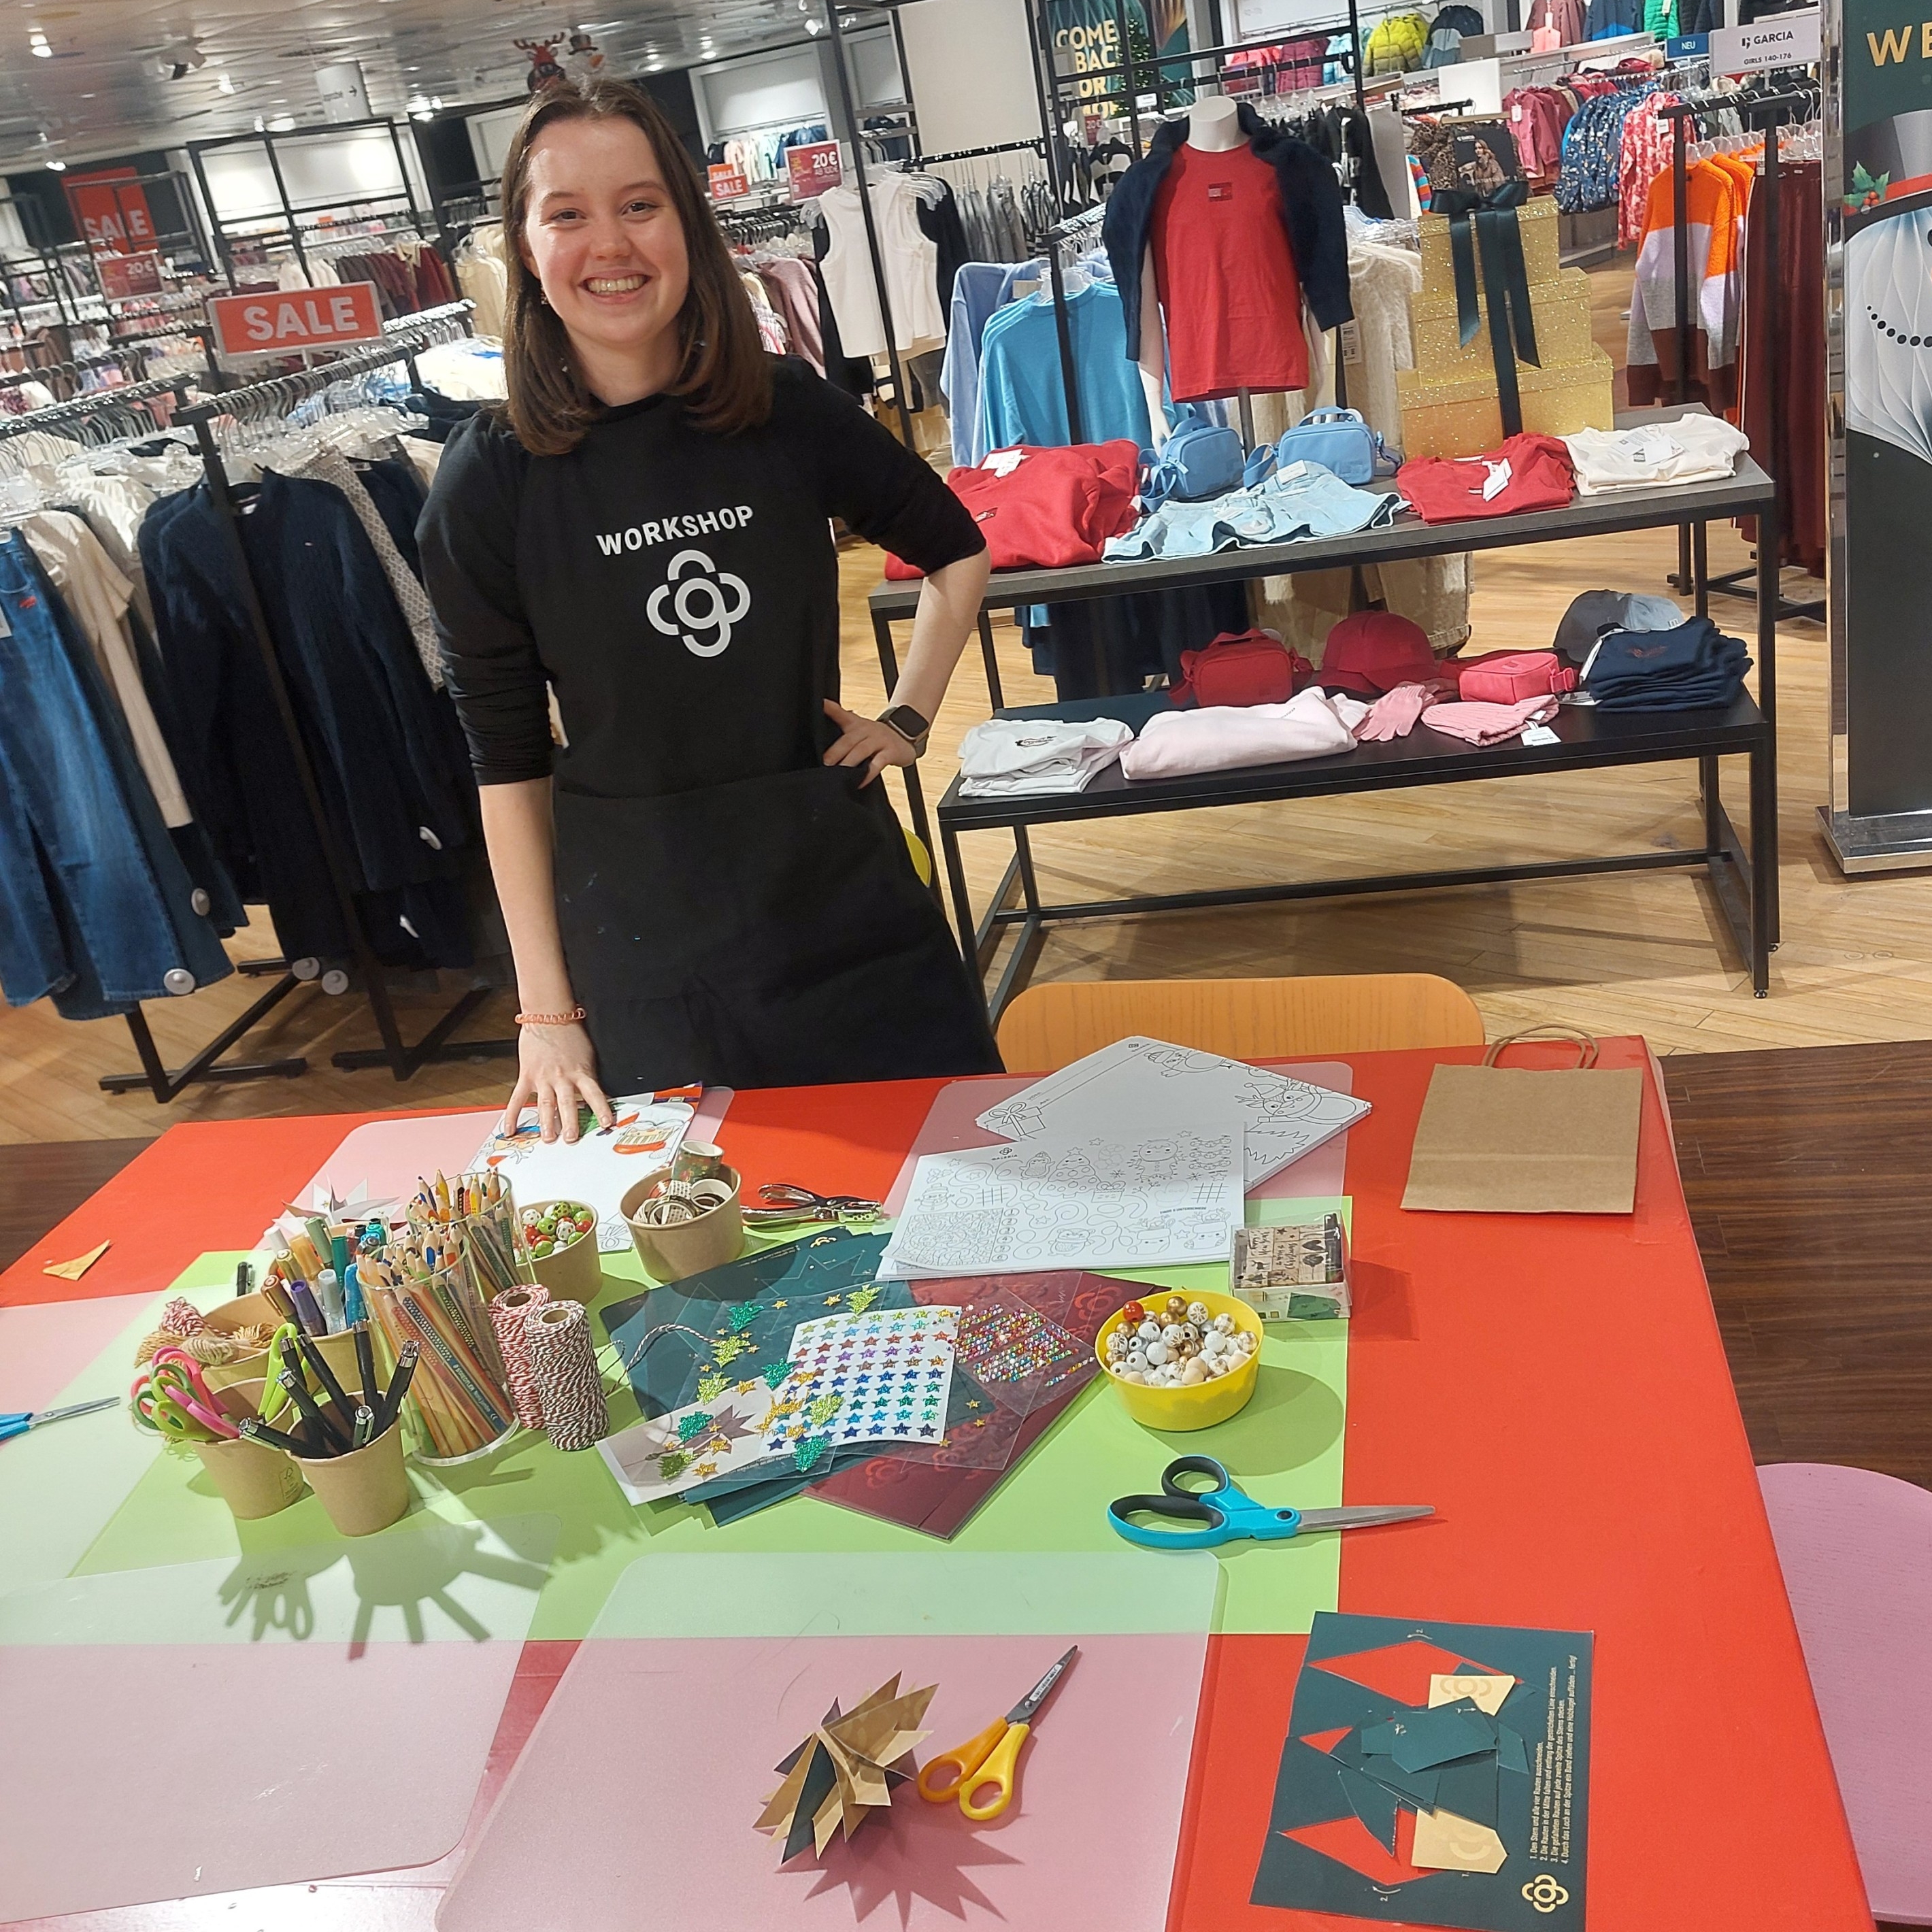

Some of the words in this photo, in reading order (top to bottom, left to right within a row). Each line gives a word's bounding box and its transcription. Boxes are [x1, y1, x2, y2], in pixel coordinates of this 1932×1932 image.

[1056, 19, 1118, 50] COME
[1682, 39, 1696, 50] NEU
[1752, 31, 1794, 45] GARCIA
[1074, 45, 1119, 73] BAC
[1744, 56, 1763, 65] GIRLS
[1764, 52, 1793, 63] 140-176
[1079, 76, 1107, 98] OR
[716, 179, 744, 197] SALE
[83, 210, 149, 239] SALE
[243, 296, 359, 341] SALE
[595, 505, 754, 556] WORKSHOP
[455, 1368, 475, 1391] STAEDTLER
[1567, 1697, 1576, 1721] Holzkugel
[1547, 1710, 1555, 1741] gestrichelten
[1535, 1742, 1544, 1776] ausschneiden.
[1545, 1751, 1554, 1769] entlang
[1556, 1746, 1564, 1761] Spitze
[1554, 1779, 1563, 1790] jede
[1541, 1826, 1549, 1844] Rauten
[1551, 1819, 1560, 1846] gefalteten
